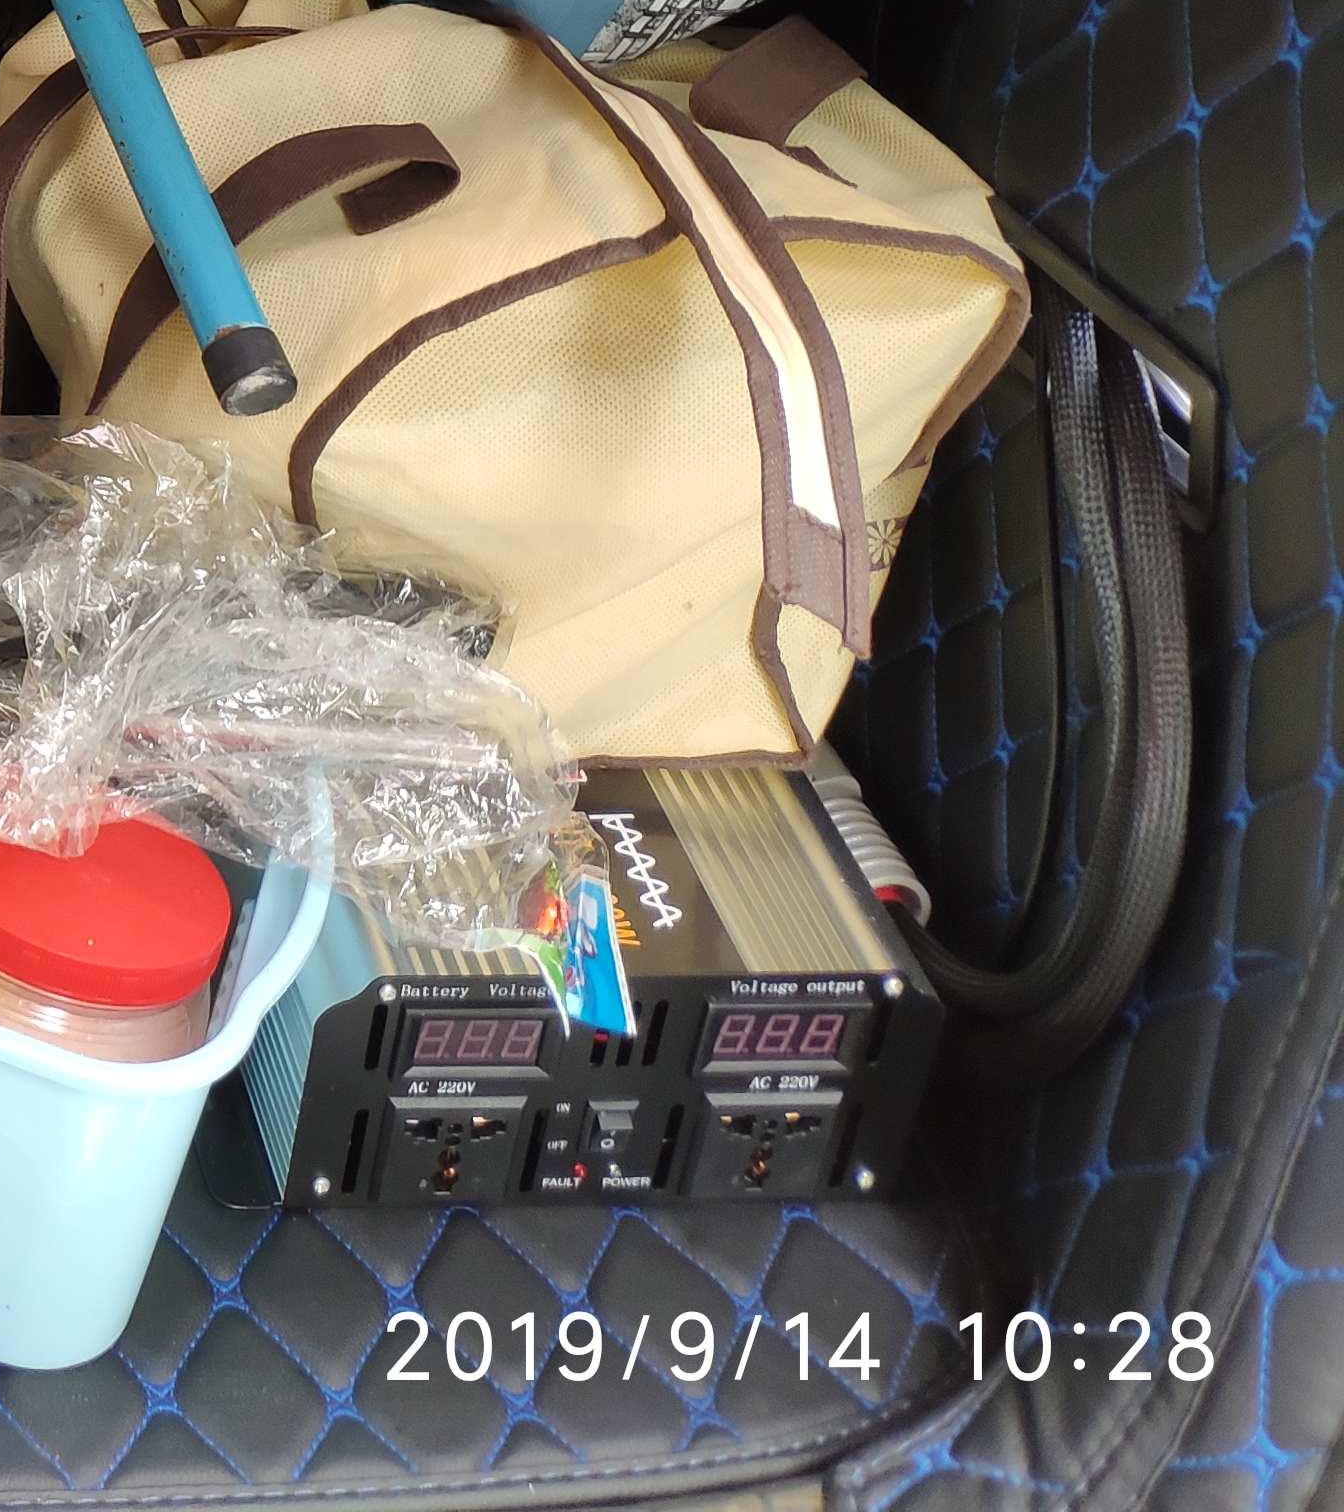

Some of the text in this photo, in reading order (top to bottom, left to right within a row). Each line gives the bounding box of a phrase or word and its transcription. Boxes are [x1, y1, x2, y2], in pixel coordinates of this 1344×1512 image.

[401, 984, 470, 999] Battery
[731, 979, 865, 996] Voltage output
[408, 1081, 476, 1094] AC 220V
[749, 1075, 820, 1089] AC 220V
[556, 1102, 571, 1113] ON
[547, 1139, 568, 1150] OFF
[542, 1177, 651, 1187] FAULT POWER
